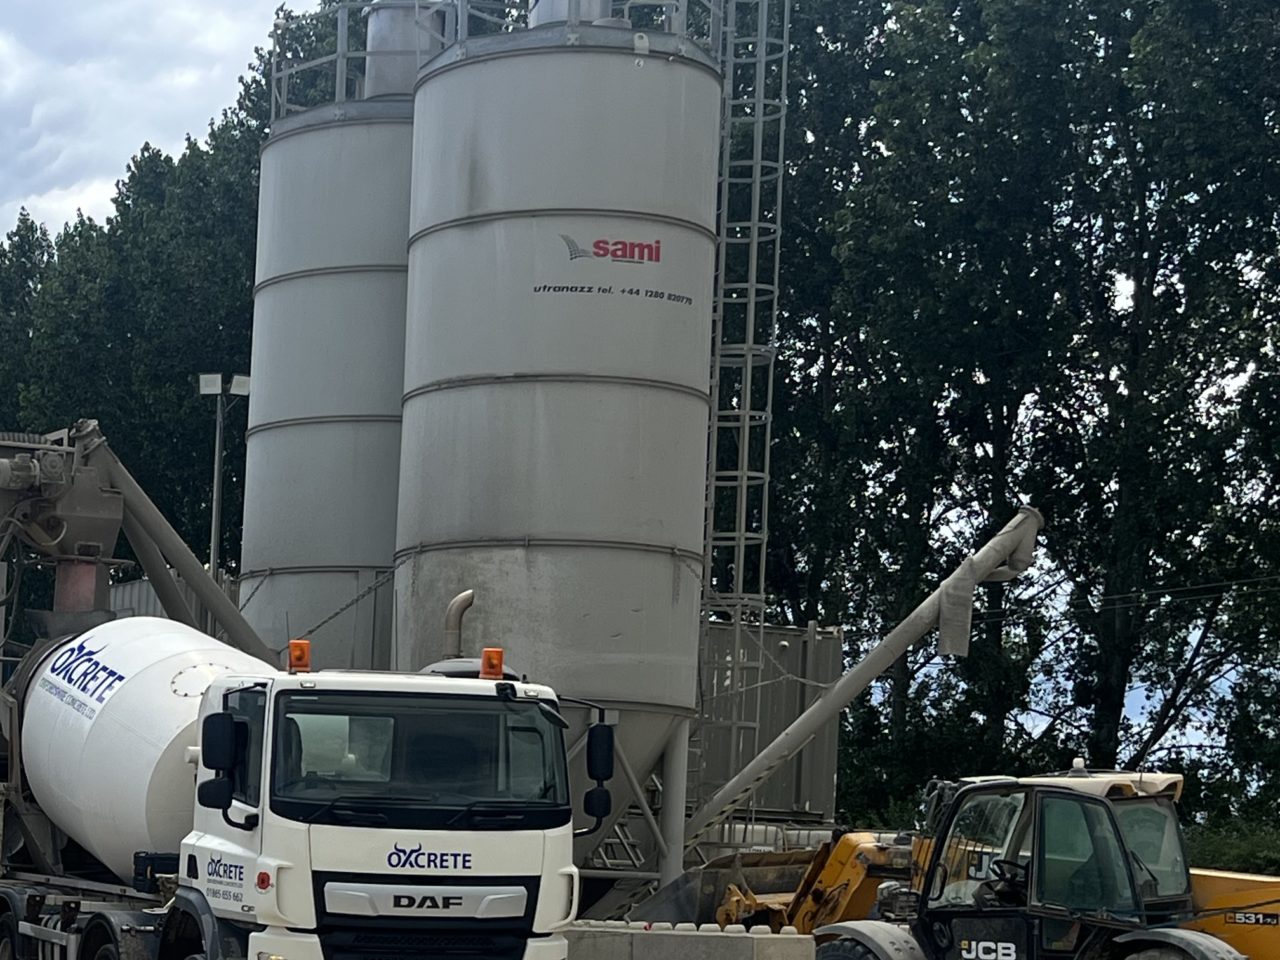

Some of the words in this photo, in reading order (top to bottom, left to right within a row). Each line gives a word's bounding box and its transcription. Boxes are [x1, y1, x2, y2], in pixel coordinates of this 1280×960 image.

[592, 239, 661, 263] sami
[620, 288, 640, 296] +44
[644, 290, 664, 299] 1280
[50, 636, 125, 704] OXCRETE
[207, 852, 244, 881] OXCRETE
[387, 842, 472, 869] OXCRETE
[393, 895, 463, 909] DAF
